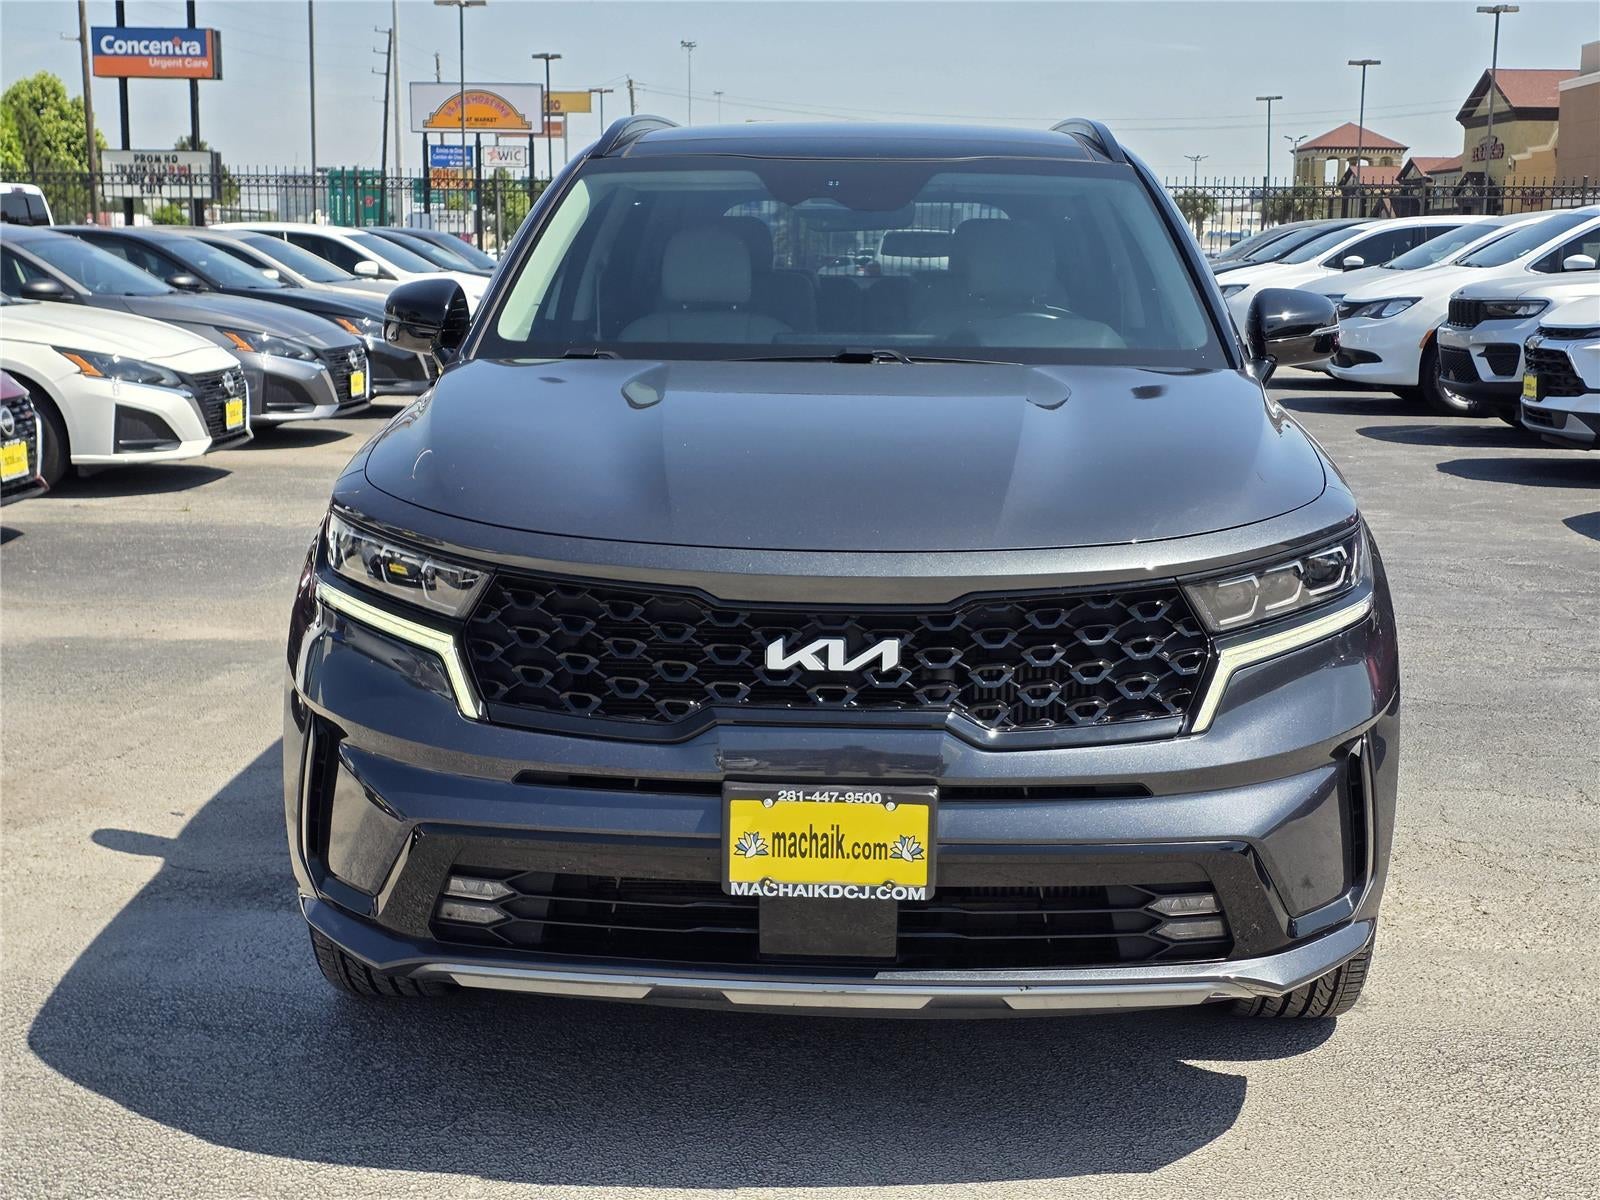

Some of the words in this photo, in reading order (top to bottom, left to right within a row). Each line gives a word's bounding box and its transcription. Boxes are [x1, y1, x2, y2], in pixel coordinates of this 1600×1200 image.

[100, 35, 201, 56] Concentra
[148, 57, 183, 69] Urgent
[185, 58, 209, 68] Care
[134, 154, 162, 163] PROM
[497, 150, 521, 161] WIC
[766, 637, 900, 672] KIA
[777, 790, 882, 804] 281-447-9500
[771, 824, 888, 860] machaik.com
[730, 882, 926, 901] MACHAIKDCJ.COM
